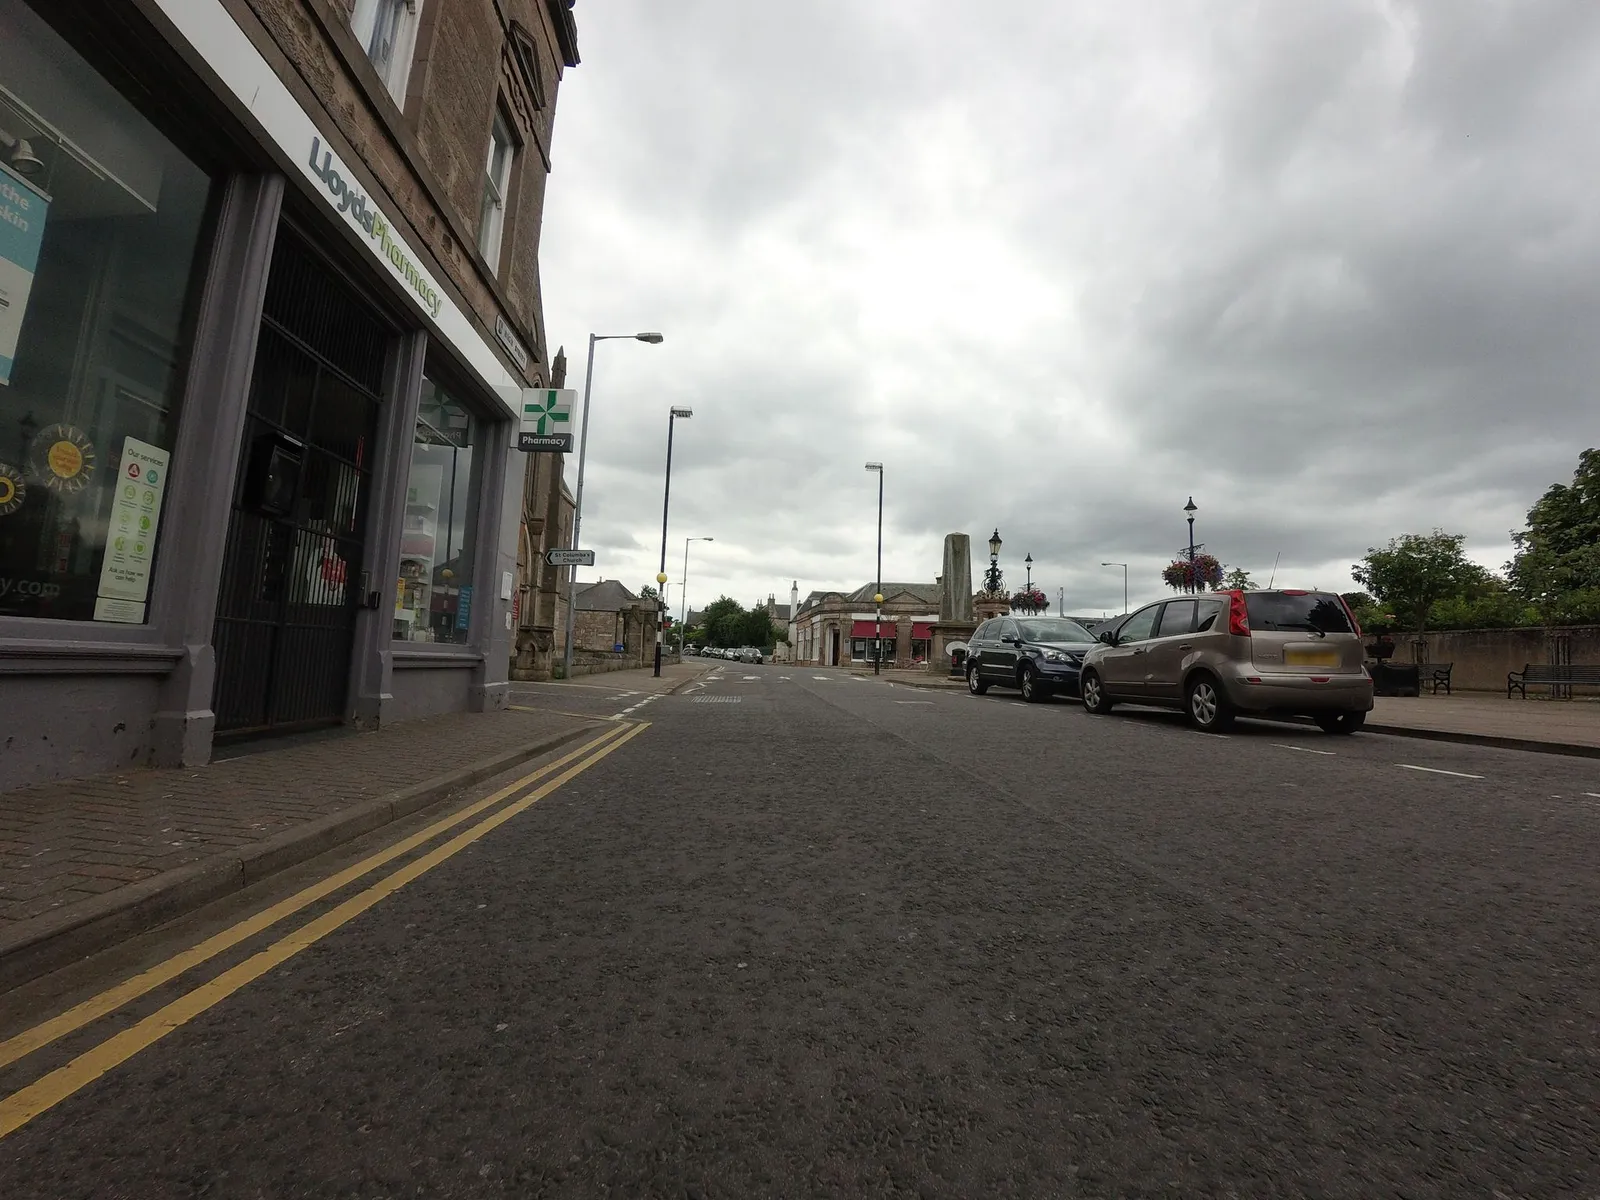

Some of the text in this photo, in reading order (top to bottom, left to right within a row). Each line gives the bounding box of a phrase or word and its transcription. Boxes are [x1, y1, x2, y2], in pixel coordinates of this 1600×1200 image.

[309, 136, 443, 319] LloydsPharmacy
[522, 435, 566, 447] Pharmacy
[128, 448, 164, 467] Our services
[108, 566, 118, 574] Ask
